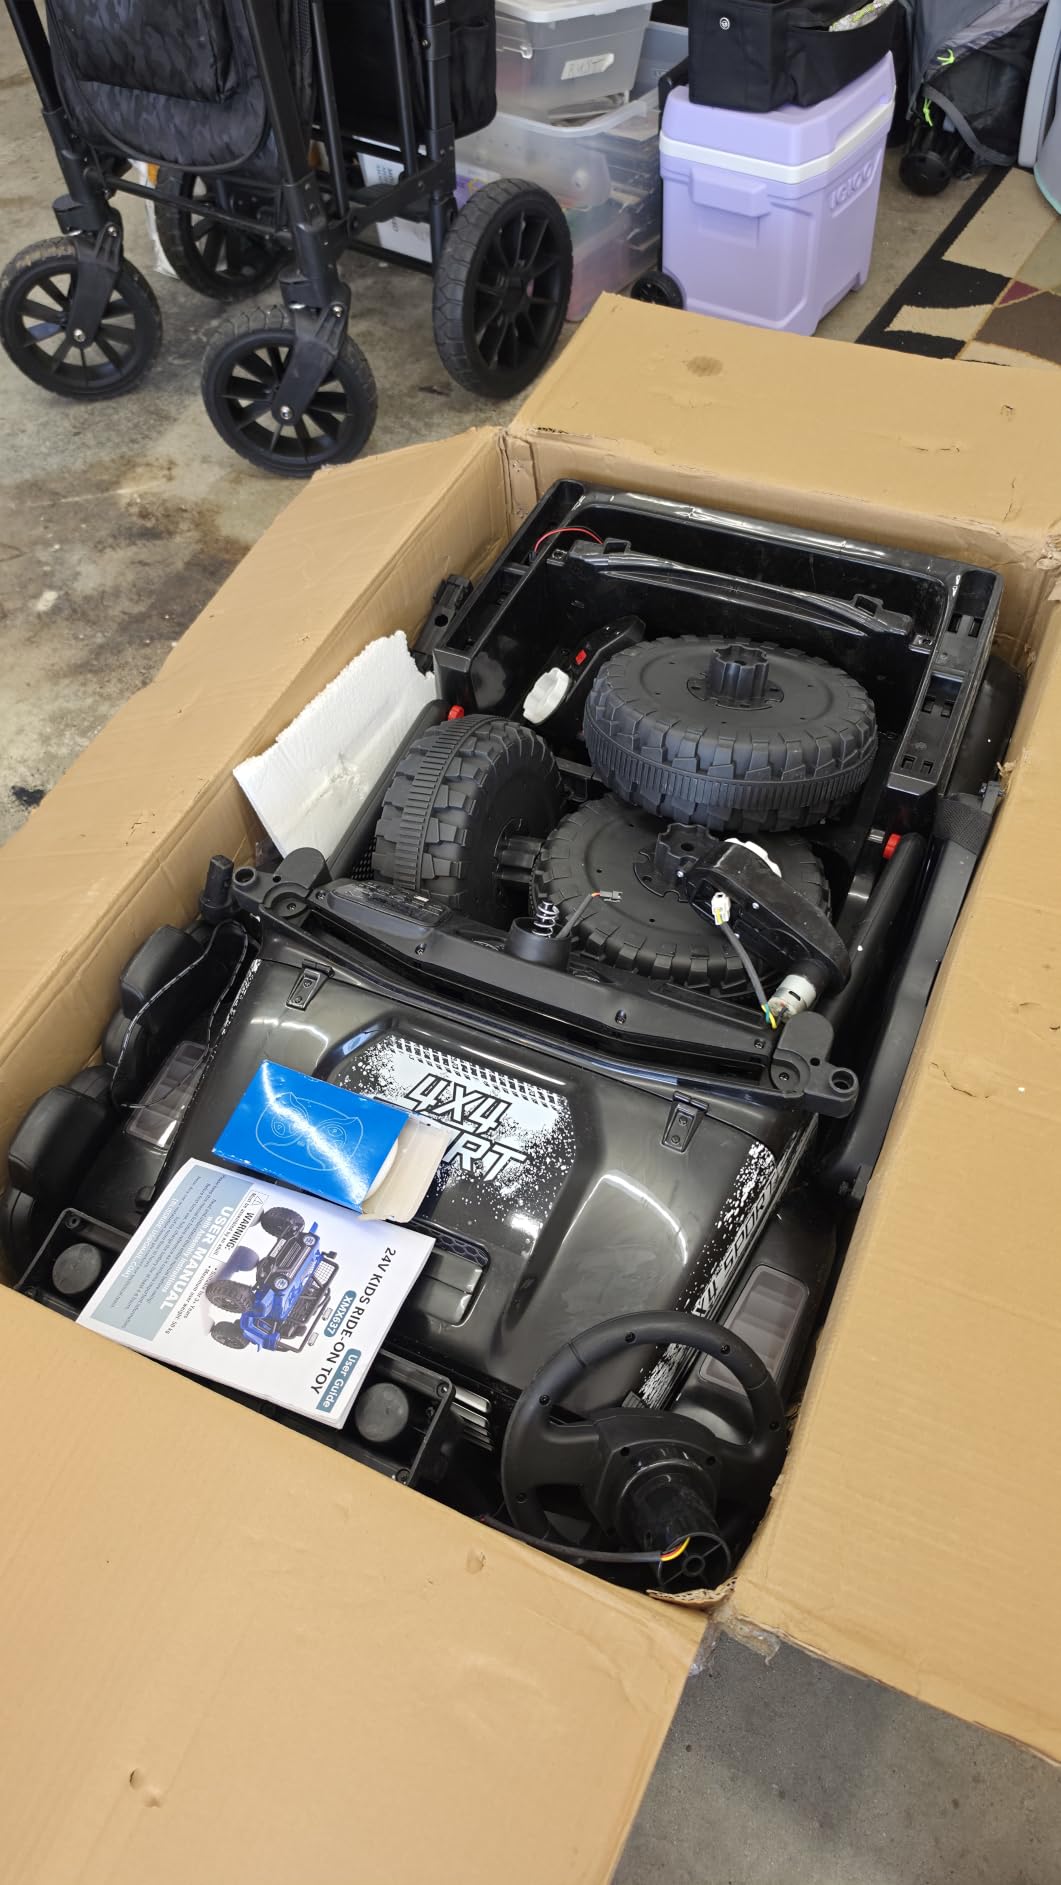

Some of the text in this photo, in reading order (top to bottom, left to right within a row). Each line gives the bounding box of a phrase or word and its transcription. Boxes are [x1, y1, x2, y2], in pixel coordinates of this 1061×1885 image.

[830, 159, 873, 210] IGLOO
[403, 1072, 513, 1135] 4X4
[245, 1191, 257, 1203] Must
[200, 1215, 215, 1229] with
[222, 1211, 255, 1251] WARNING:
[156, 1204, 235, 1312] USER MANUAL
[181, 1228, 207, 1258] Assembly
[158, 1256, 189, 1294] Instructions
[182, 1304, 196, 1320] Years
[308, 1246, 397, 1395] 24V KIDS RIDE-ON TOY
[324, 1294, 353, 1335] XMX637
[320, 1352, 358, 1410] User Guide
